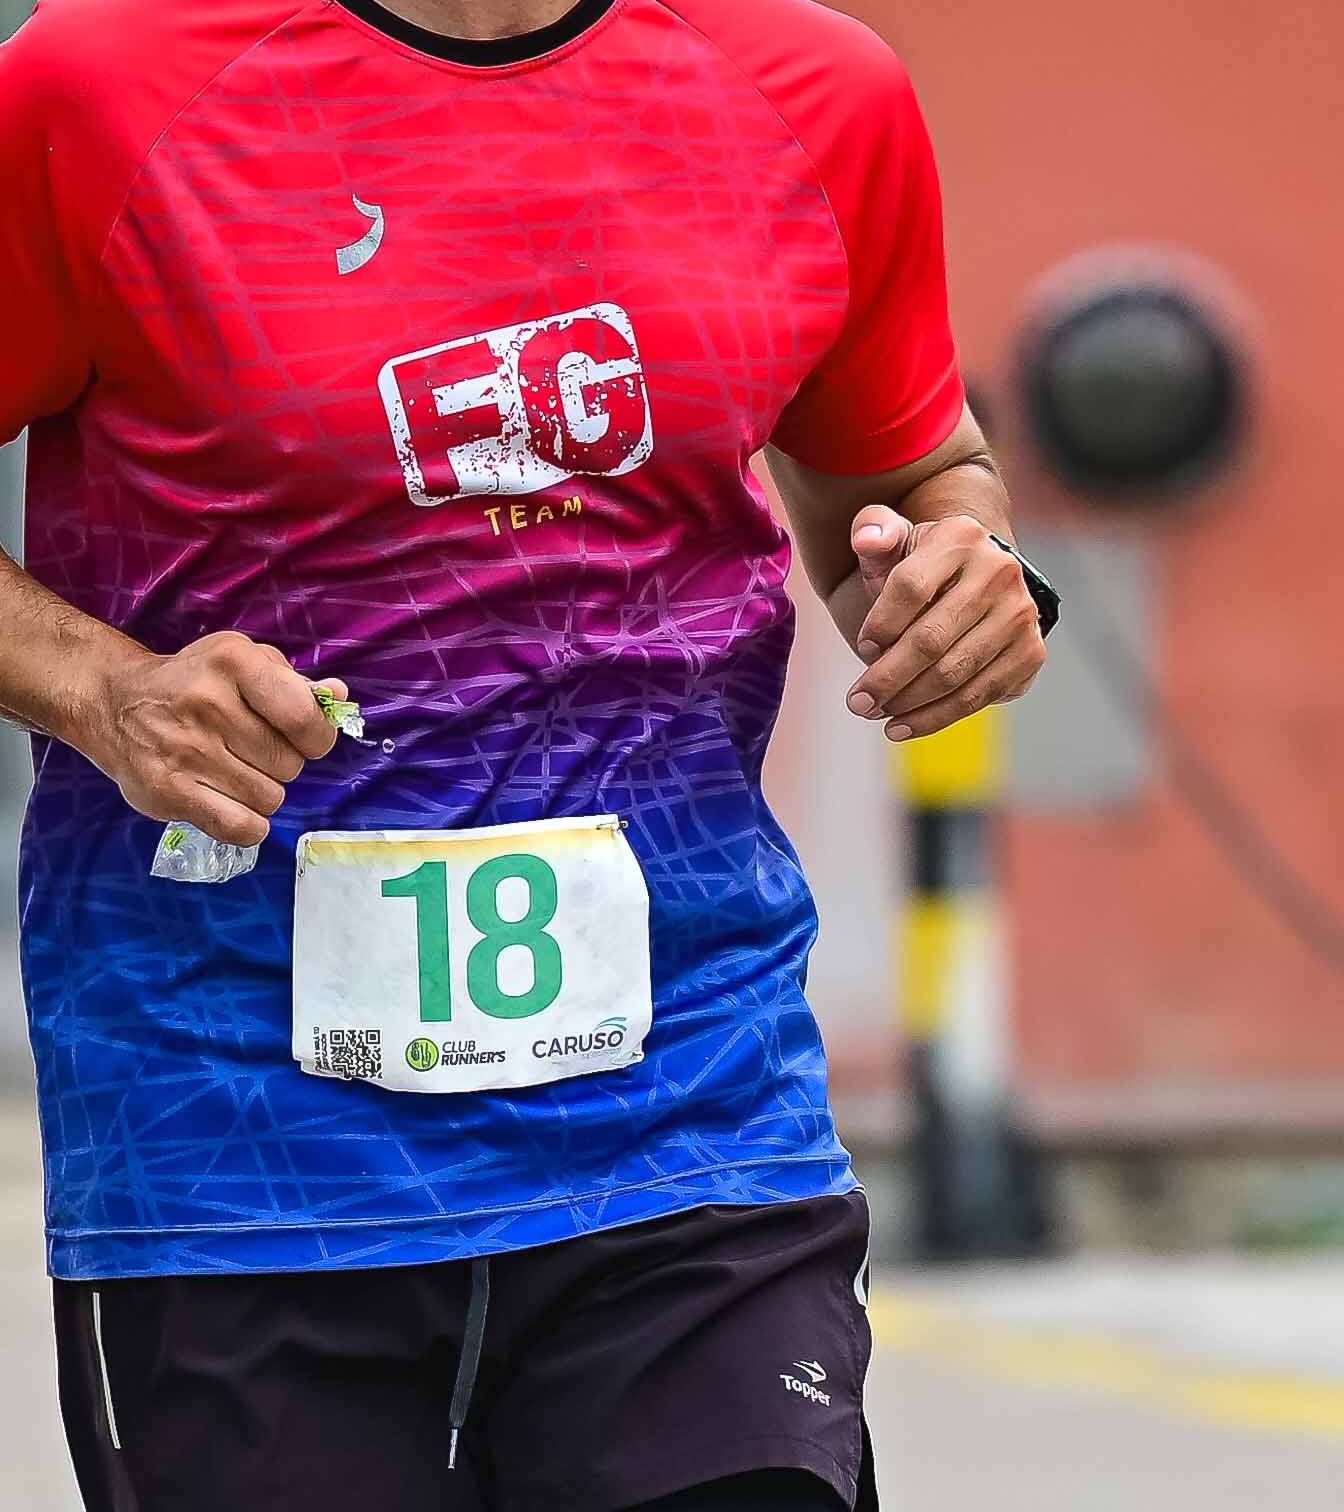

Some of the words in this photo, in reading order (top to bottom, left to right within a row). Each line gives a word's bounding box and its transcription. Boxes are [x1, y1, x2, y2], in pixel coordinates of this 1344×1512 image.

[483, 494, 584, 537] TEAM
[380, 853, 563, 1023] 18
[441, 1050, 506, 1066] RUNNER'S
[442, 1040, 476, 1053] CLUB
[531, 1029, 625, 1059] CARUSO
[779, 1374, 831, 1407] Topper
